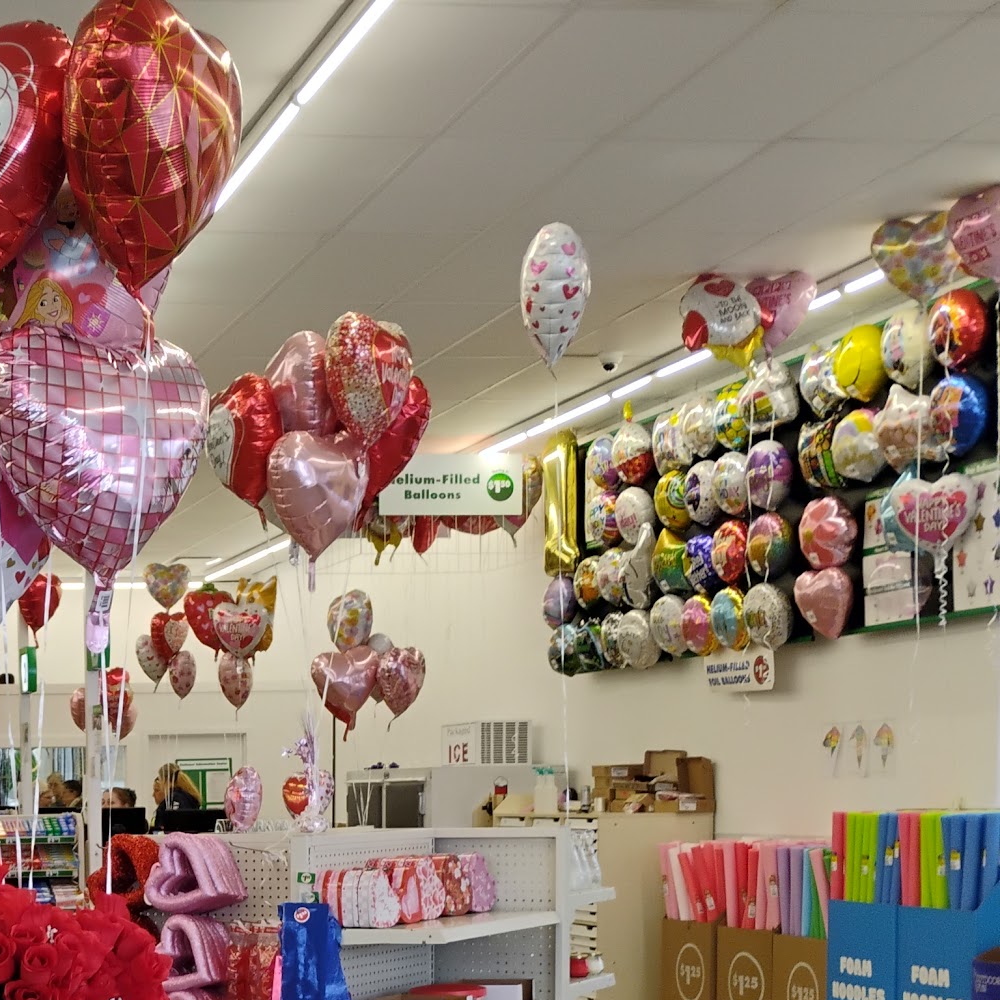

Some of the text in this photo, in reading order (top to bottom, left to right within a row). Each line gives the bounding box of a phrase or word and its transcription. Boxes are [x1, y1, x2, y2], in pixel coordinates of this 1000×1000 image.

[718, 302, 748, 316] MOON
[404, 489, 461, 500] Balloons
[448, 742, 469, 763] ICE
[839, 955, 873, 978] FOAM
[910, 964, 950, 989] FOAM
